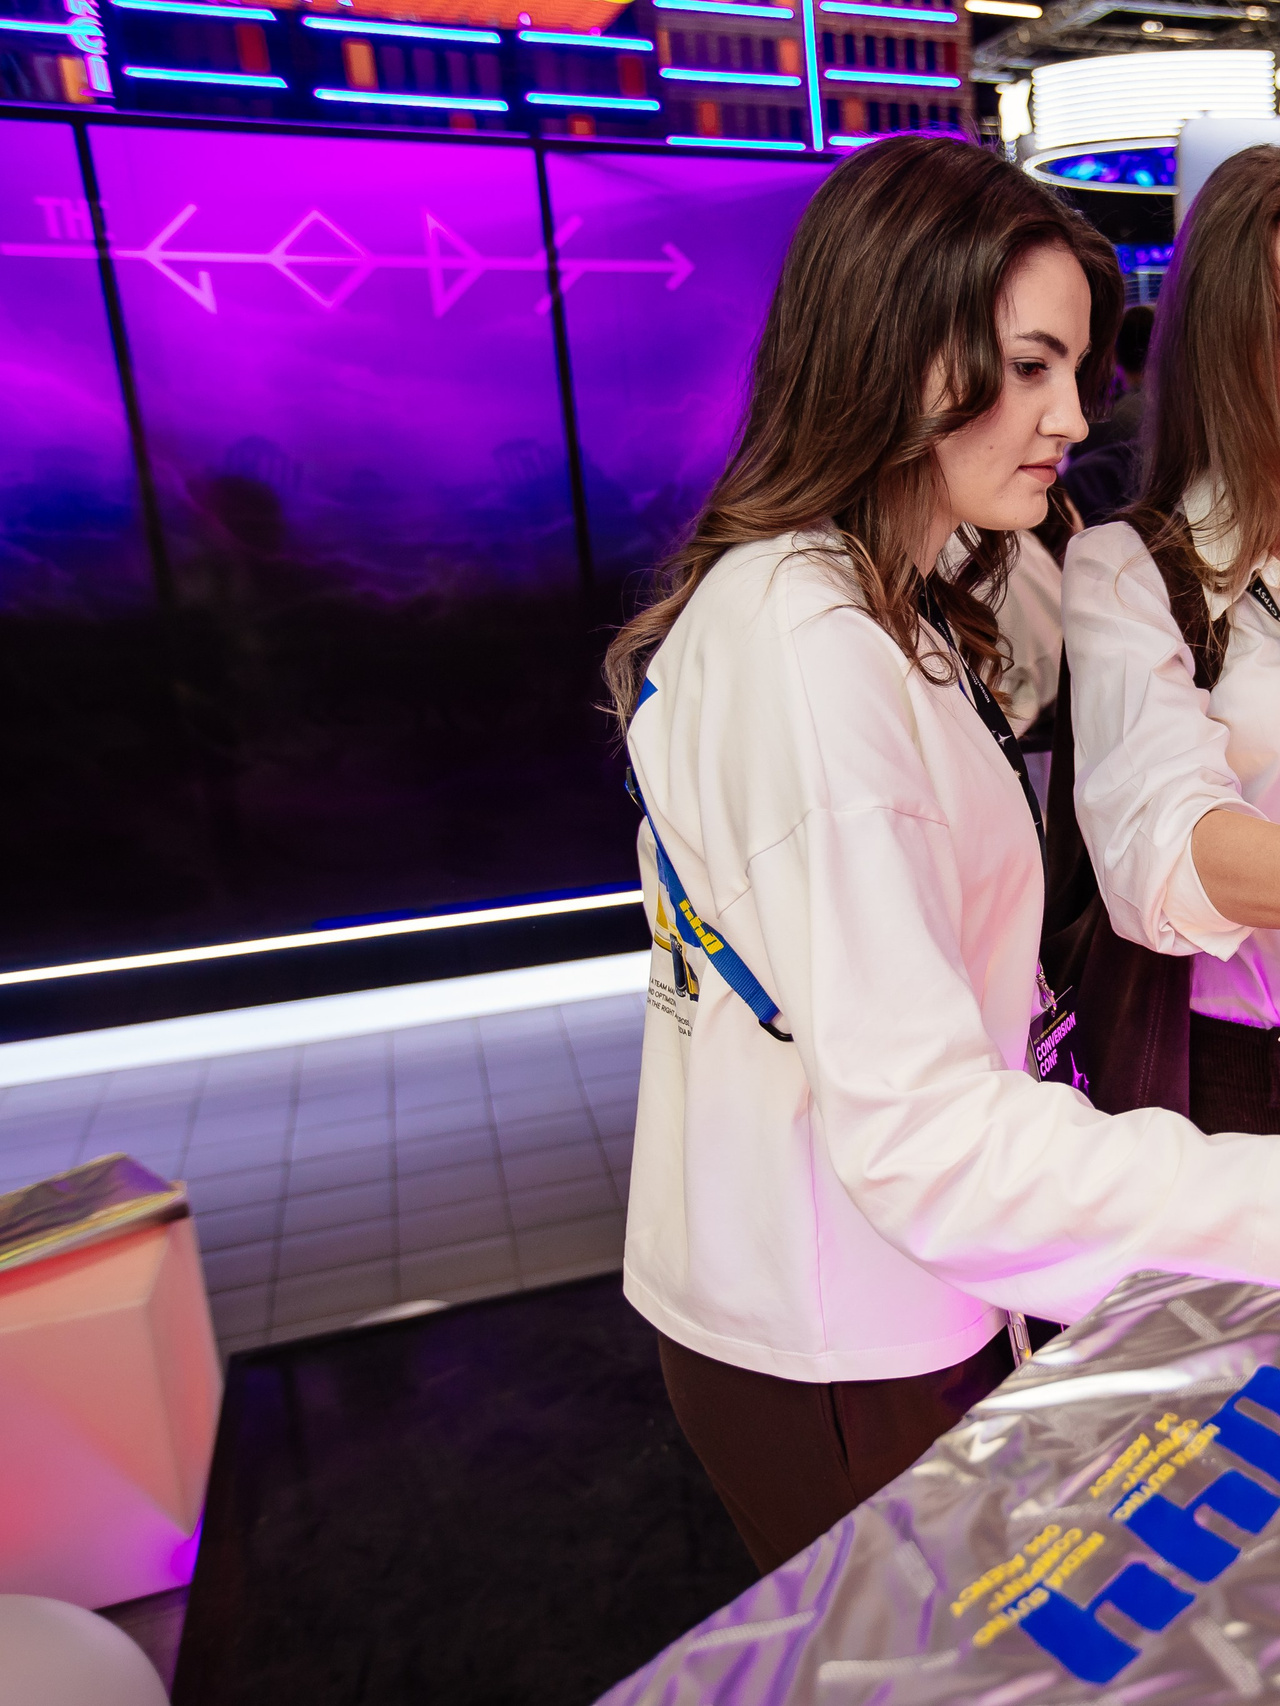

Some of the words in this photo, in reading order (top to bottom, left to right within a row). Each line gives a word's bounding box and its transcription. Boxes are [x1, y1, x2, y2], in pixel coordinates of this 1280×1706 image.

[1256, 587, 1278, 617] GYPSY
[651, 999, 661, 1010] THE
[662, 1004, 675, 1018] RIGHT
[654, 980, 668, 991] TEAM
[1036, 1011, 1077, 1061] CONVERSION
[1040, 1048, 1058, 1077] CONF
[1088, 1433, 1150, 1498] AGENCY
[1114, 1463, 1176, 1521] BUYING
[950, 1553, 1027, 1619] AGENCY
[1043, 1531, 1106, 1590] MEDIA
[972, 1587, 1050, 1648] BUYING
